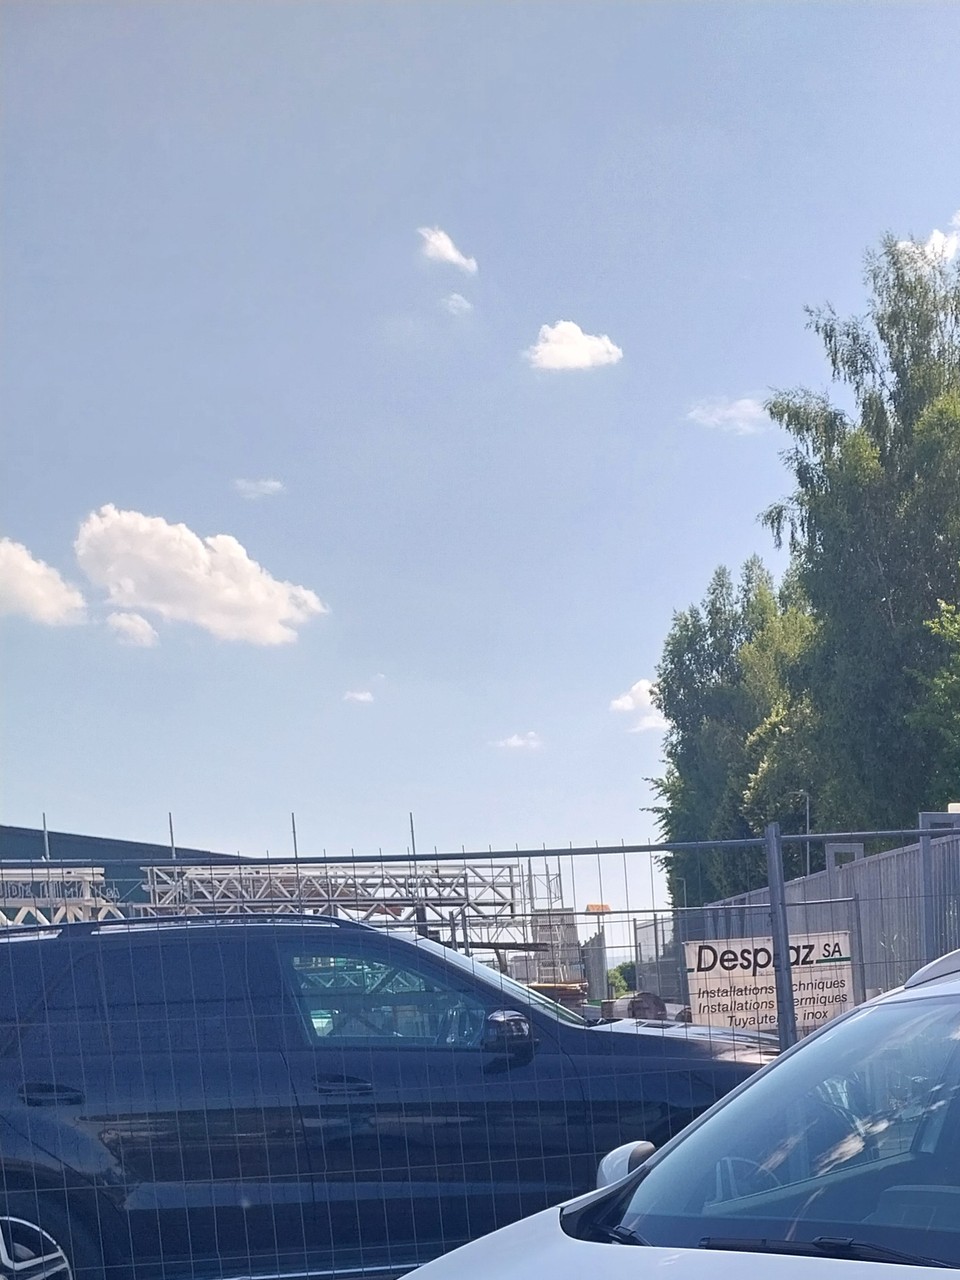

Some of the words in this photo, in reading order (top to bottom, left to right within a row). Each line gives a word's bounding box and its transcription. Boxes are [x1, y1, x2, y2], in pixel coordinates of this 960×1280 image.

[697, 944, 815, 977] Despaz
[822, 942, 843, 958] SA
[698, 984, 775, 999] Installations
[791, 979, 846, 992] chniques
[698, 1000, 775, 1014] Installations
[793, 993, 848, 1006] ermiques
[803, 1009, 829, 1021] inox
